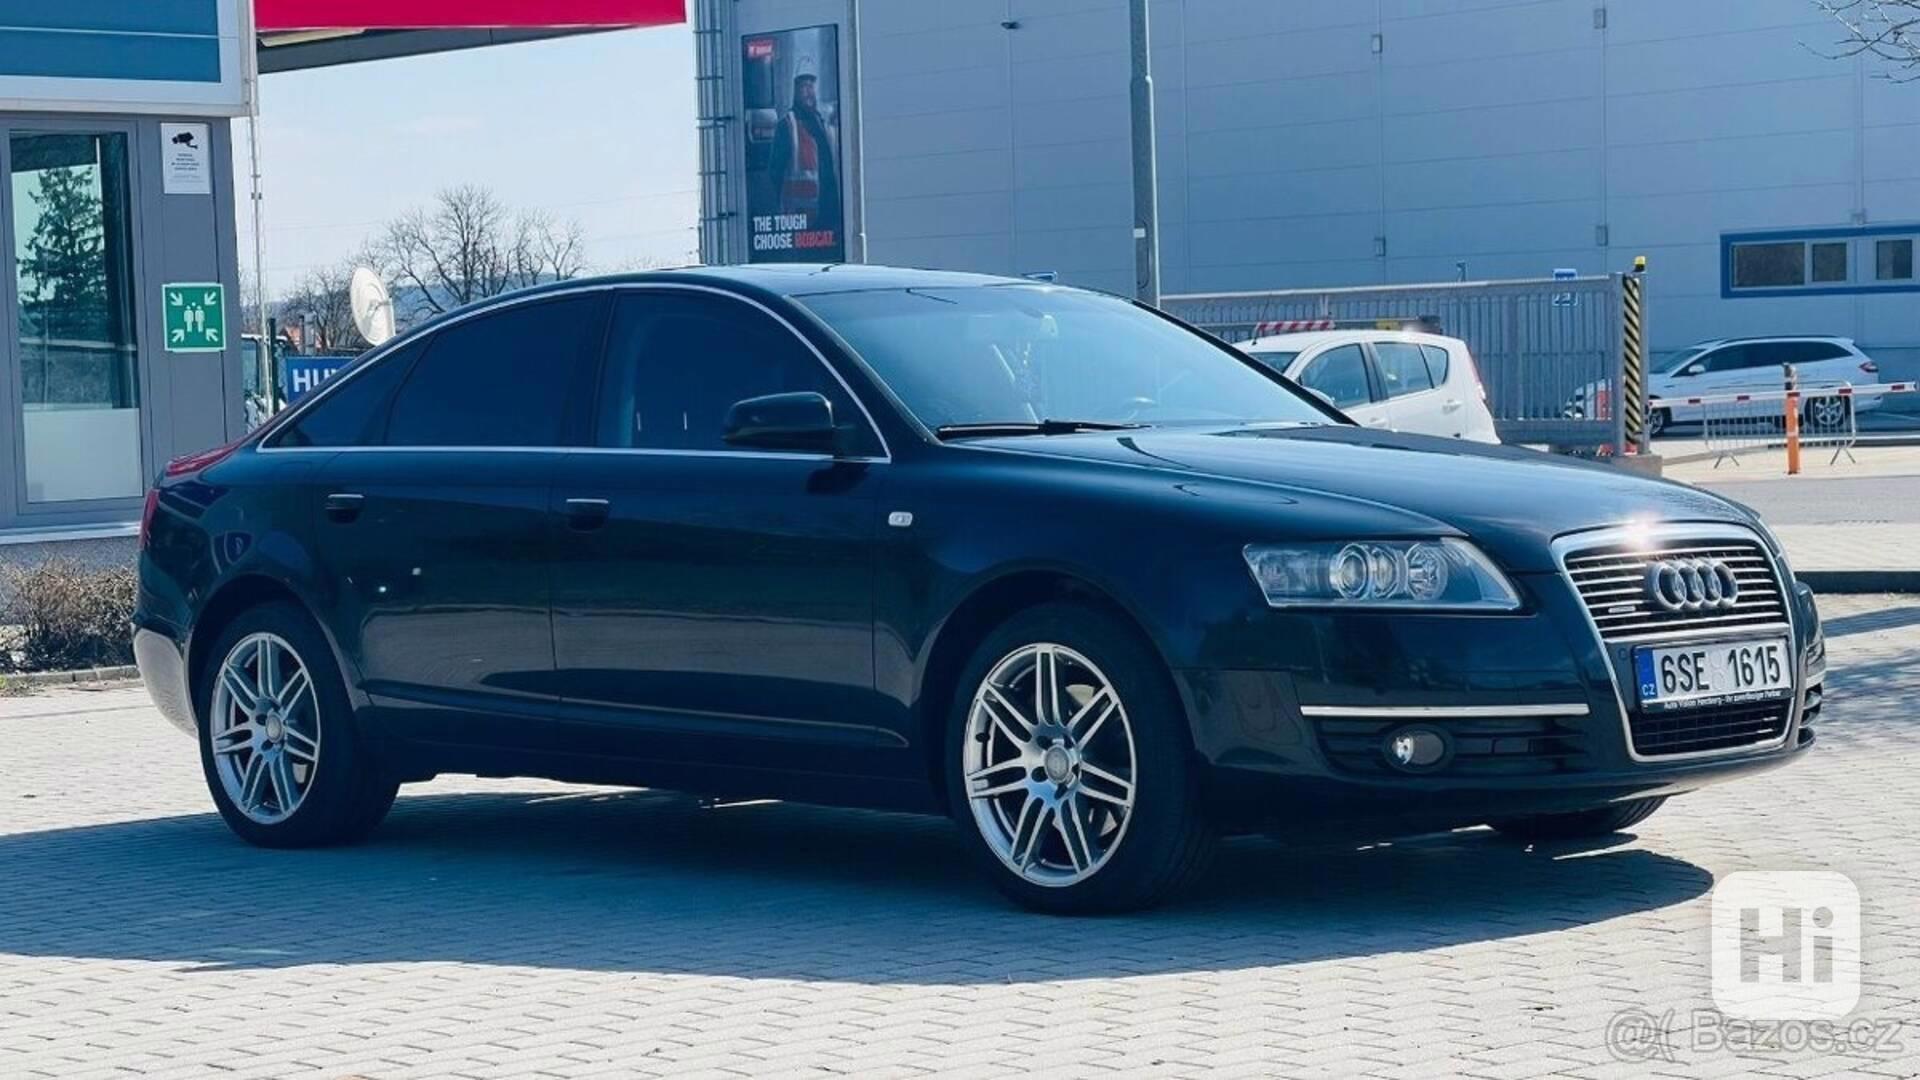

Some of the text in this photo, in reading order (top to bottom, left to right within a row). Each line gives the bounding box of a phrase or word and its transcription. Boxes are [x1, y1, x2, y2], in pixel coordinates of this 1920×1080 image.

[753, 214, 807, 232] THE TOUGH
[754, 233, 793, 250] CHOOSE
[1661, 646, 1780, 693] 6SE 1615
[1642, 684, 1656, 695] CZ
